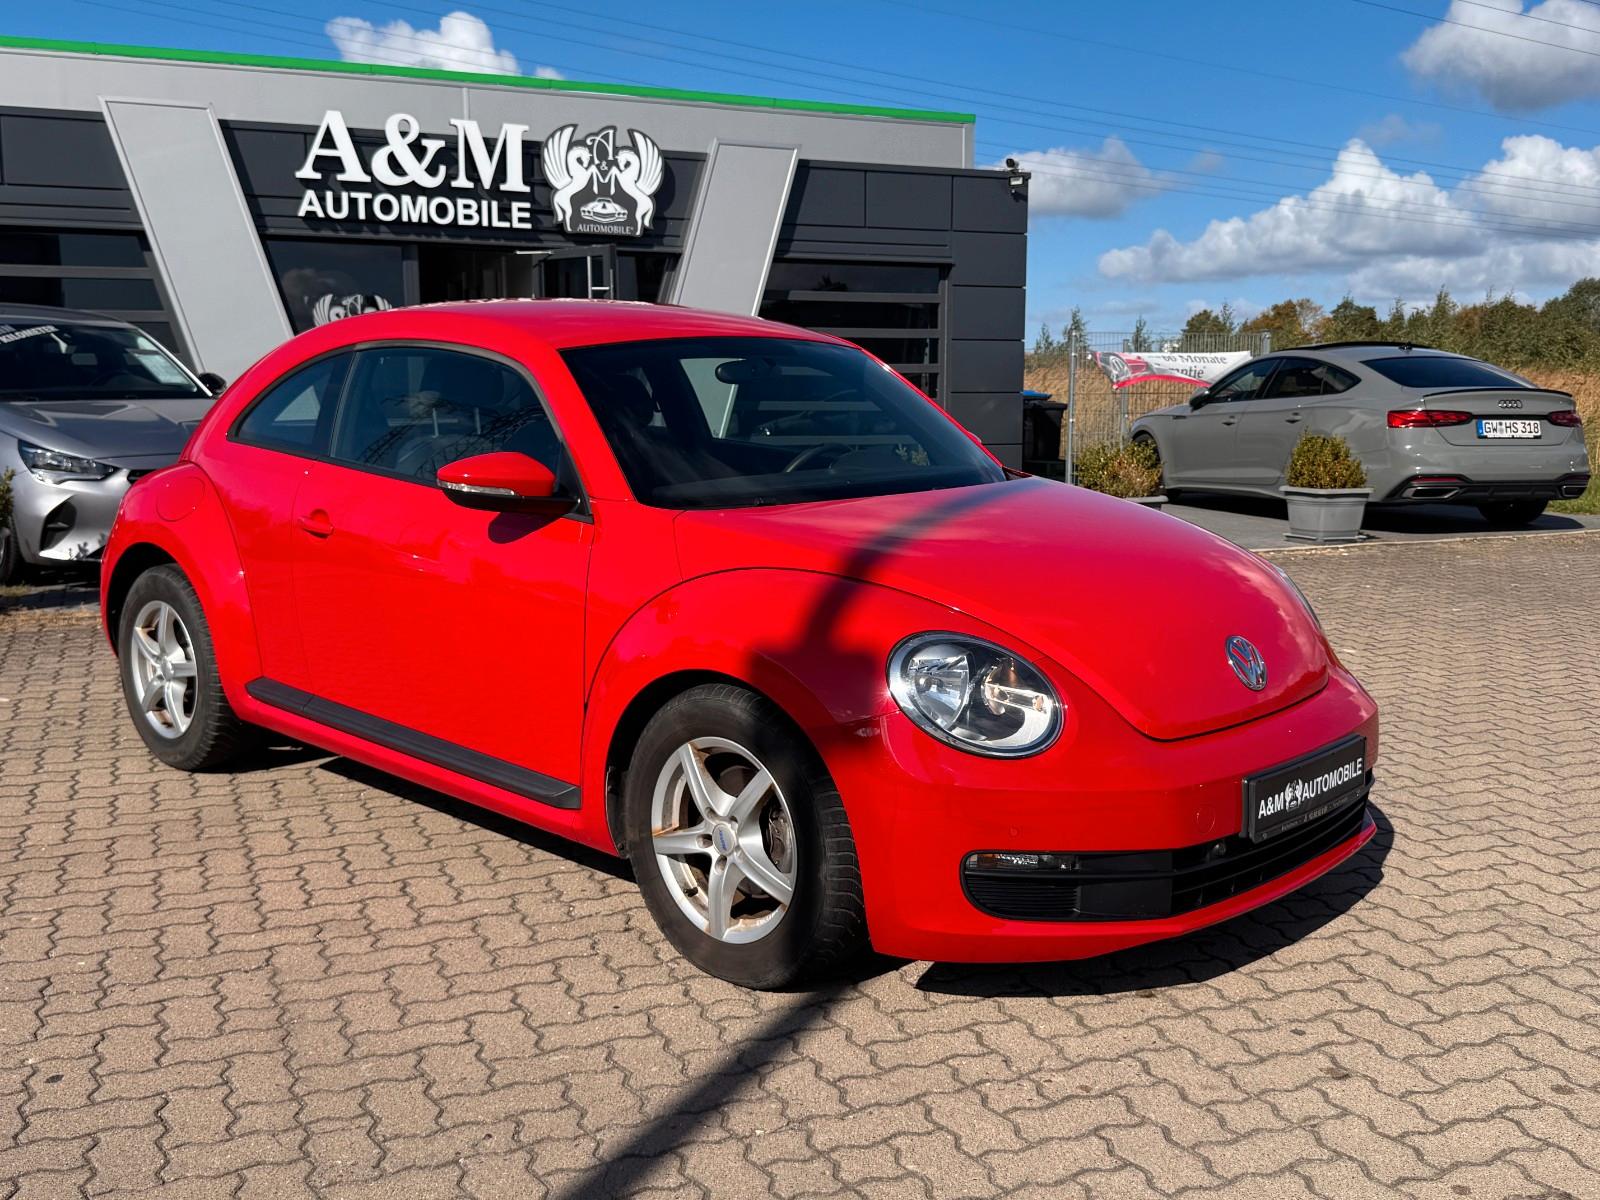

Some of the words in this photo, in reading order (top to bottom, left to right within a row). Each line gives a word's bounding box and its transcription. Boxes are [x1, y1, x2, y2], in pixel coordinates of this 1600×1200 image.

[295, 110, 530, 193] A&M
[297, 190, 532, 230] AUTOMOBILE
[577, 223, 632, 234] AUTOMOBILE
[1178, 354, 1227, 364] Monate
[1484, 421, 1498, 433] GW
[1521, 421, 1539, 433] 318
[1258, 791, 1284, 819] A&M
[1302, 757, 1363, 802] AUTOMOBILE
